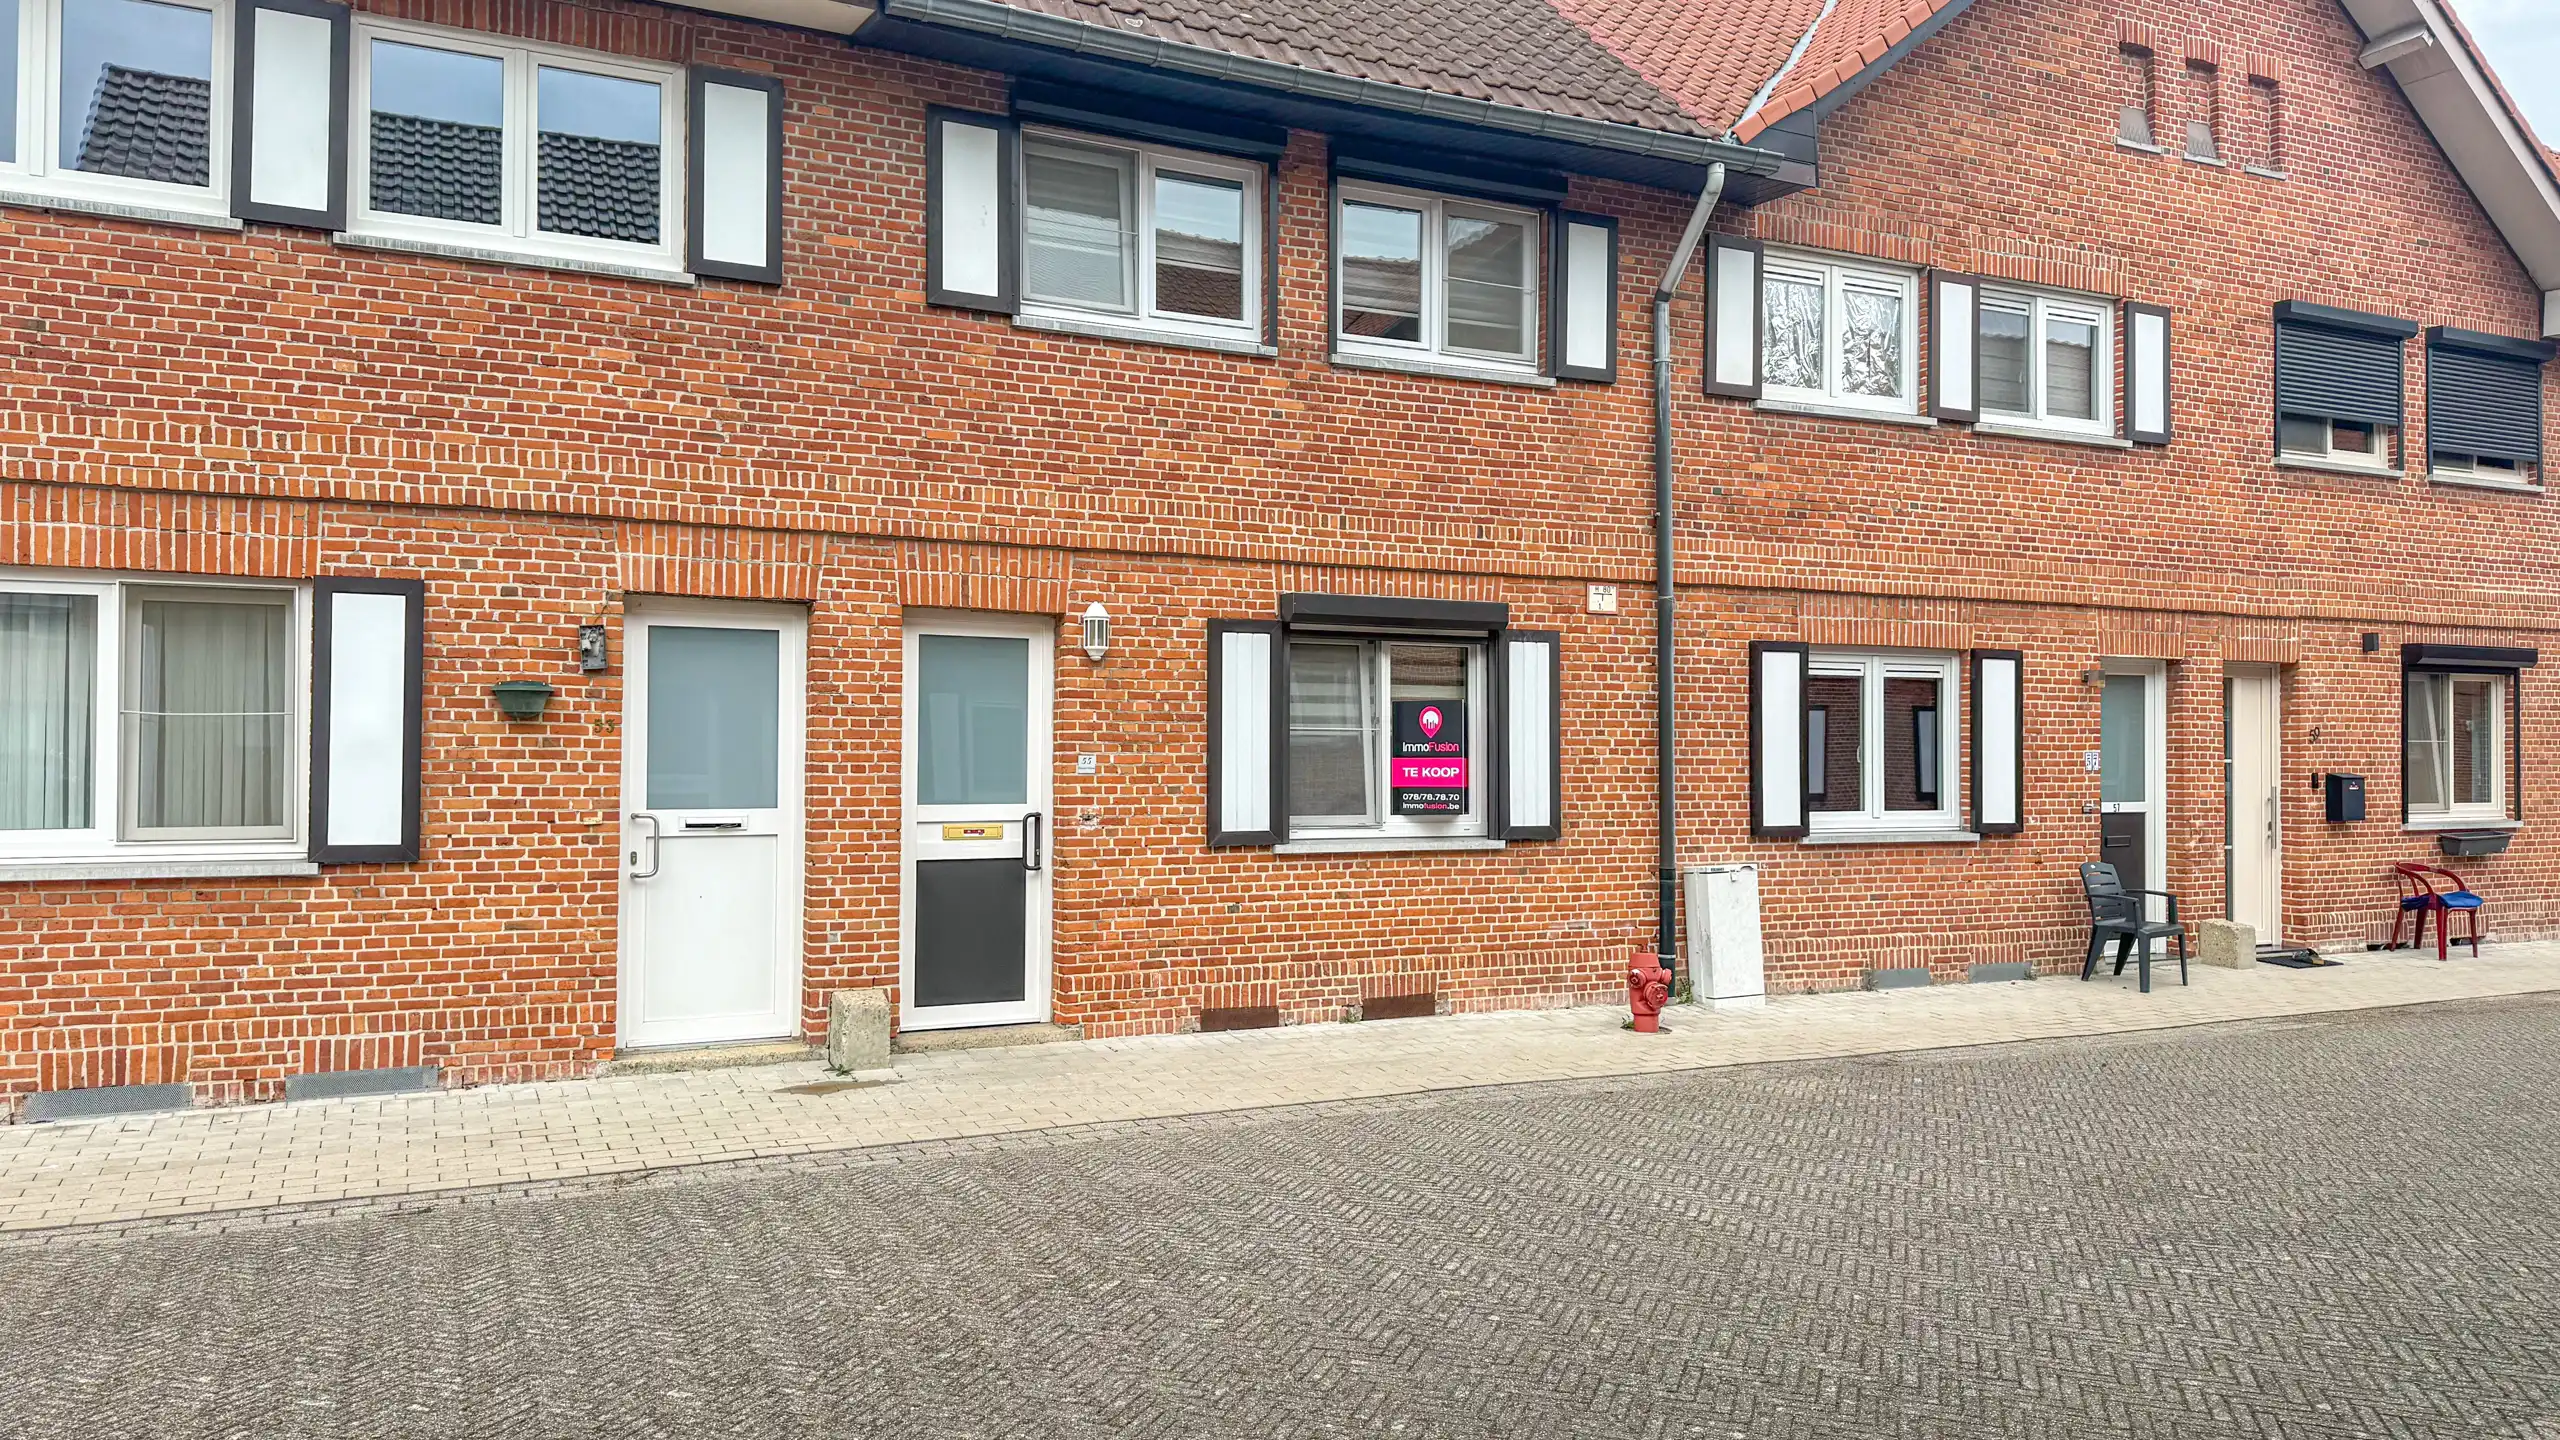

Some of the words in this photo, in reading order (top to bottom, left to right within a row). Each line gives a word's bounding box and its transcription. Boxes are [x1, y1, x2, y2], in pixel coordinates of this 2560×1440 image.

[593, 718, 616, 734] 53
[1402, 741, 1459, 752] ImmoFusion
[1402, 767, 1419, 777] TE
[1422, 767, 1460, 777] KOOP
[1402, 793, 1460, 801] 078/78.78.70
